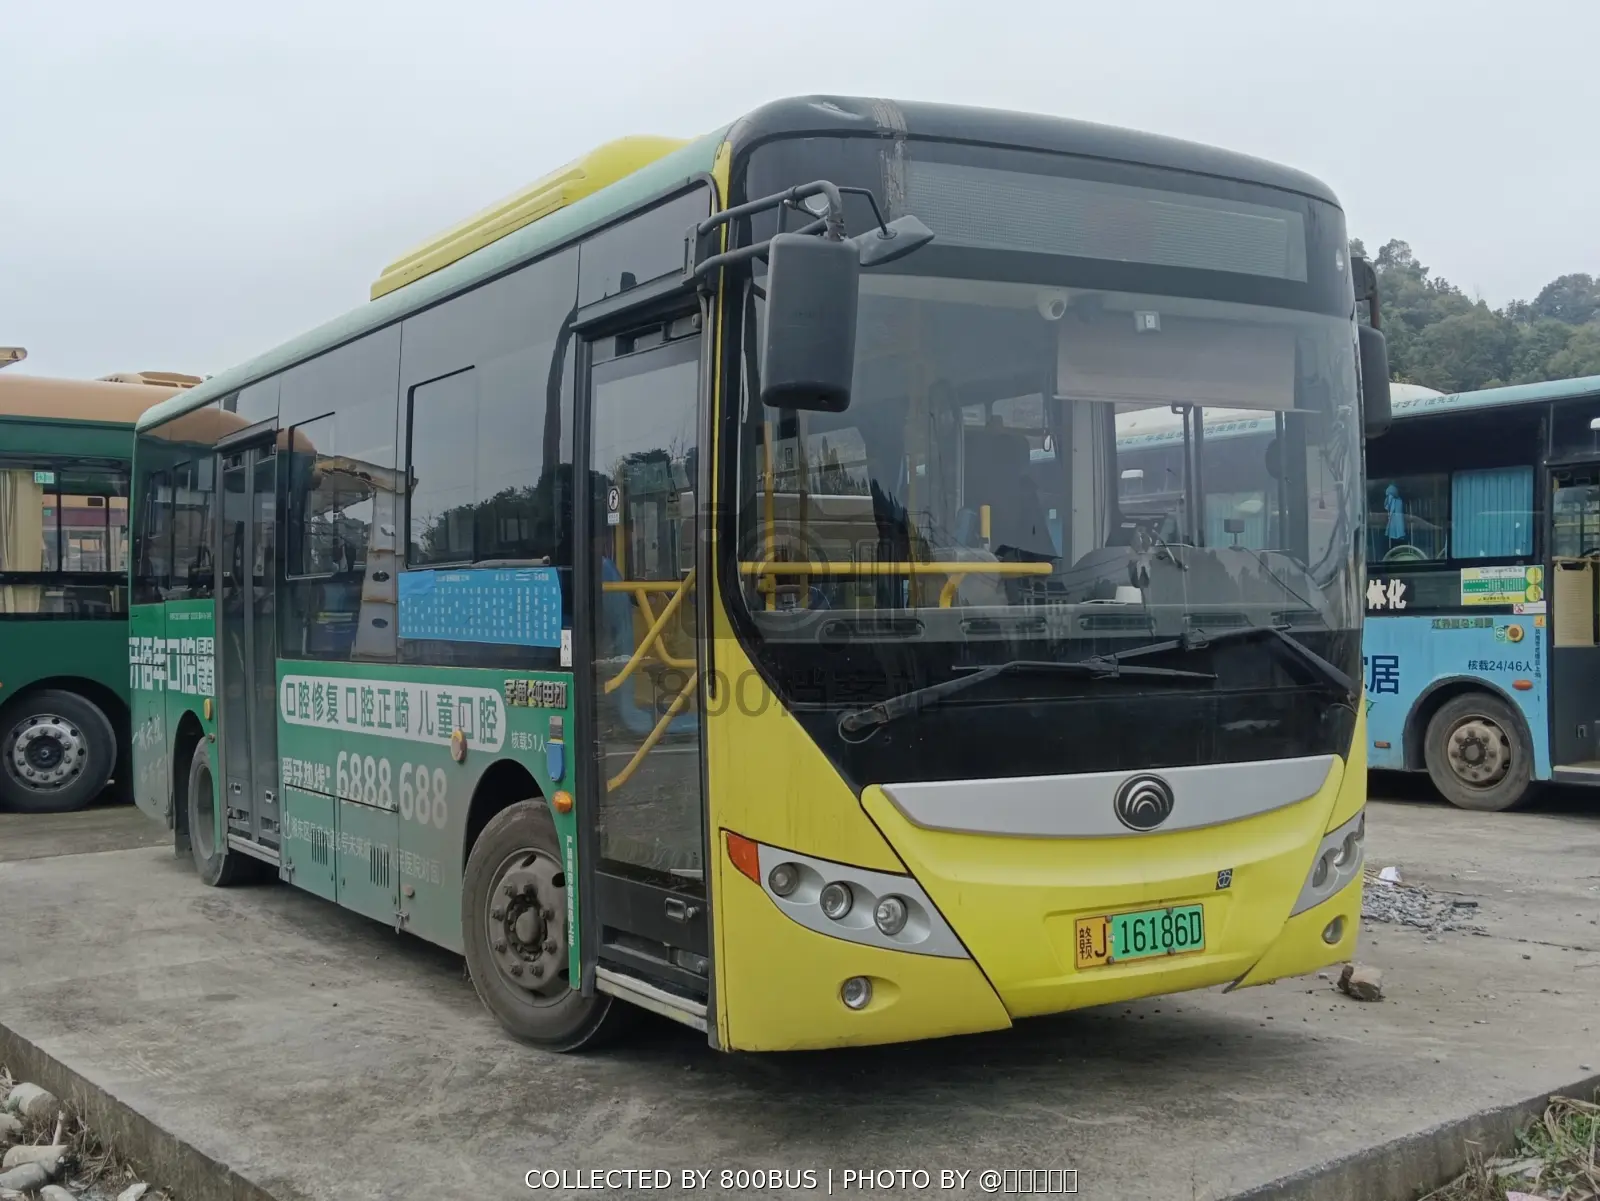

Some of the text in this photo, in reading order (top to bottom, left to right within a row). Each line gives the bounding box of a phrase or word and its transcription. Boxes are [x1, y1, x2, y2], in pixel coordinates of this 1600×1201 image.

[1362, 655, 1399, 694] 居
[1468, 660, 1533, 671] 核载24/46人
[285, 681, 498, 745] 口腔修复 口腔正畸 儿童口腔
[511, 731, 547, 753] 核载51人
[400, 762, 447, 830] 688
[1079, 911, 1201, 960] 赣J 16186D
